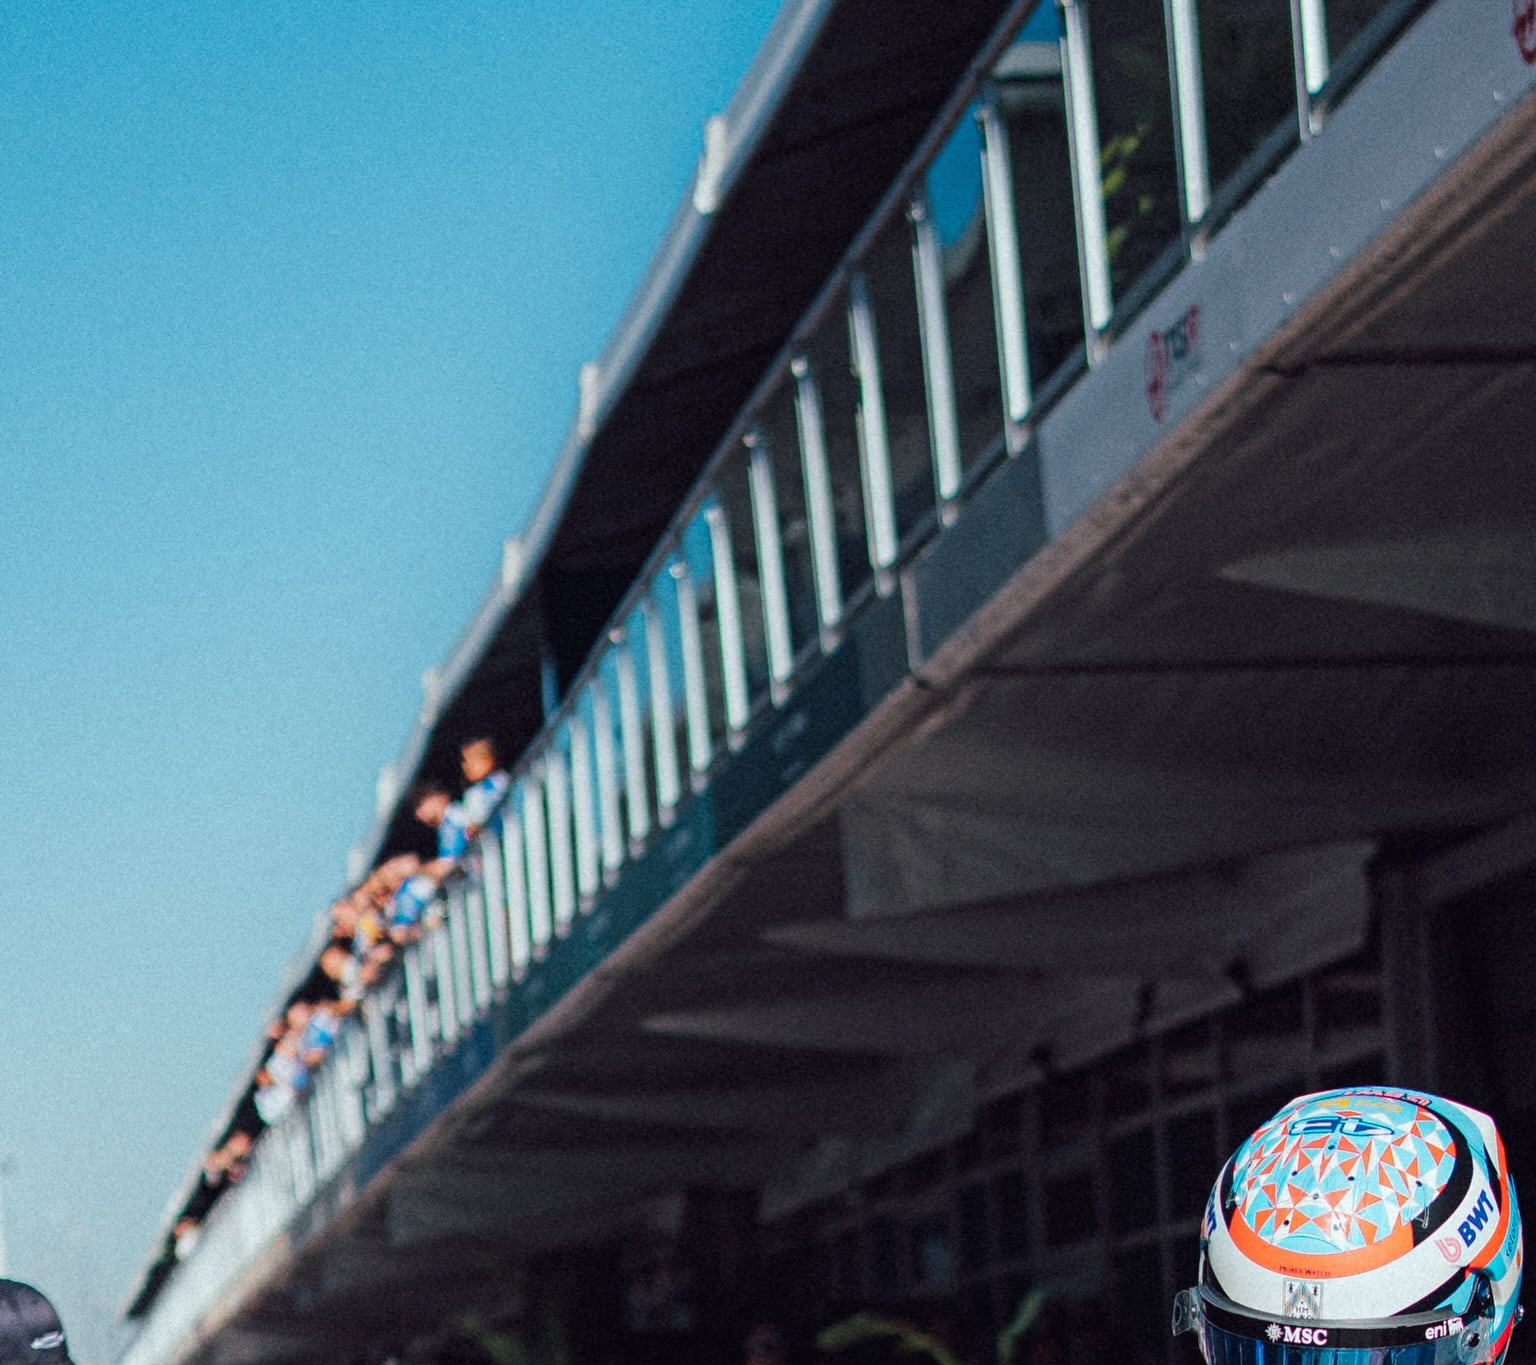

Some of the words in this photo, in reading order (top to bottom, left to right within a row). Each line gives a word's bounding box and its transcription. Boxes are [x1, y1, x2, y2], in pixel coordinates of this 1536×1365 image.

[1458, 1189, 1495, 1248] BWT
[1283, 1326, 1329, 1346] MSC
[1425, 1319, 1448, 1340] eni
